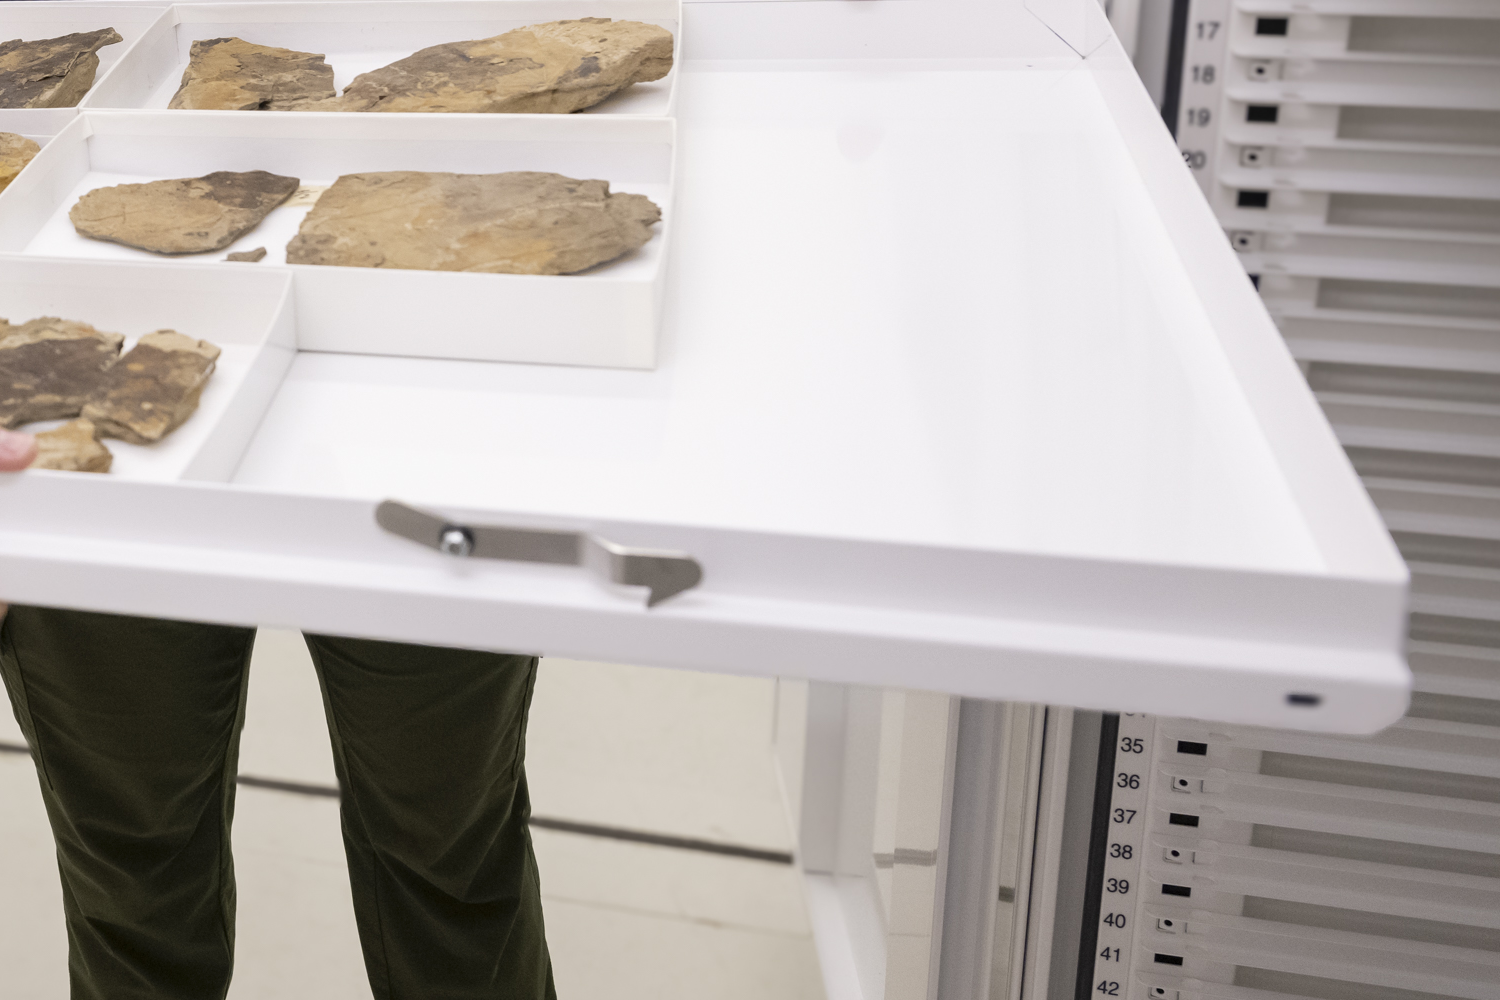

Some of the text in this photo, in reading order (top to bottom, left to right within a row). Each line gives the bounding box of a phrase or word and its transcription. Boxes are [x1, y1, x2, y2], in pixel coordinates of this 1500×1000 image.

[1196, 21, 1220, 40] 17
[1191, 65, 1215, 84] 18
[1187, 108, 1210, 127] 19
[1120, 737, 1144, 754] 35
[1117, 773, 1140, 790] 36
[1113, 808, 1137, 825] 37
[1109, 843, 1133, 860] 38
[1106, 878, 1130, 894] 39
[1103, 912, 1126, 929] 40
[1100, 946, 1121, 963] 41
[1096, 980, 1120, 997] 42
